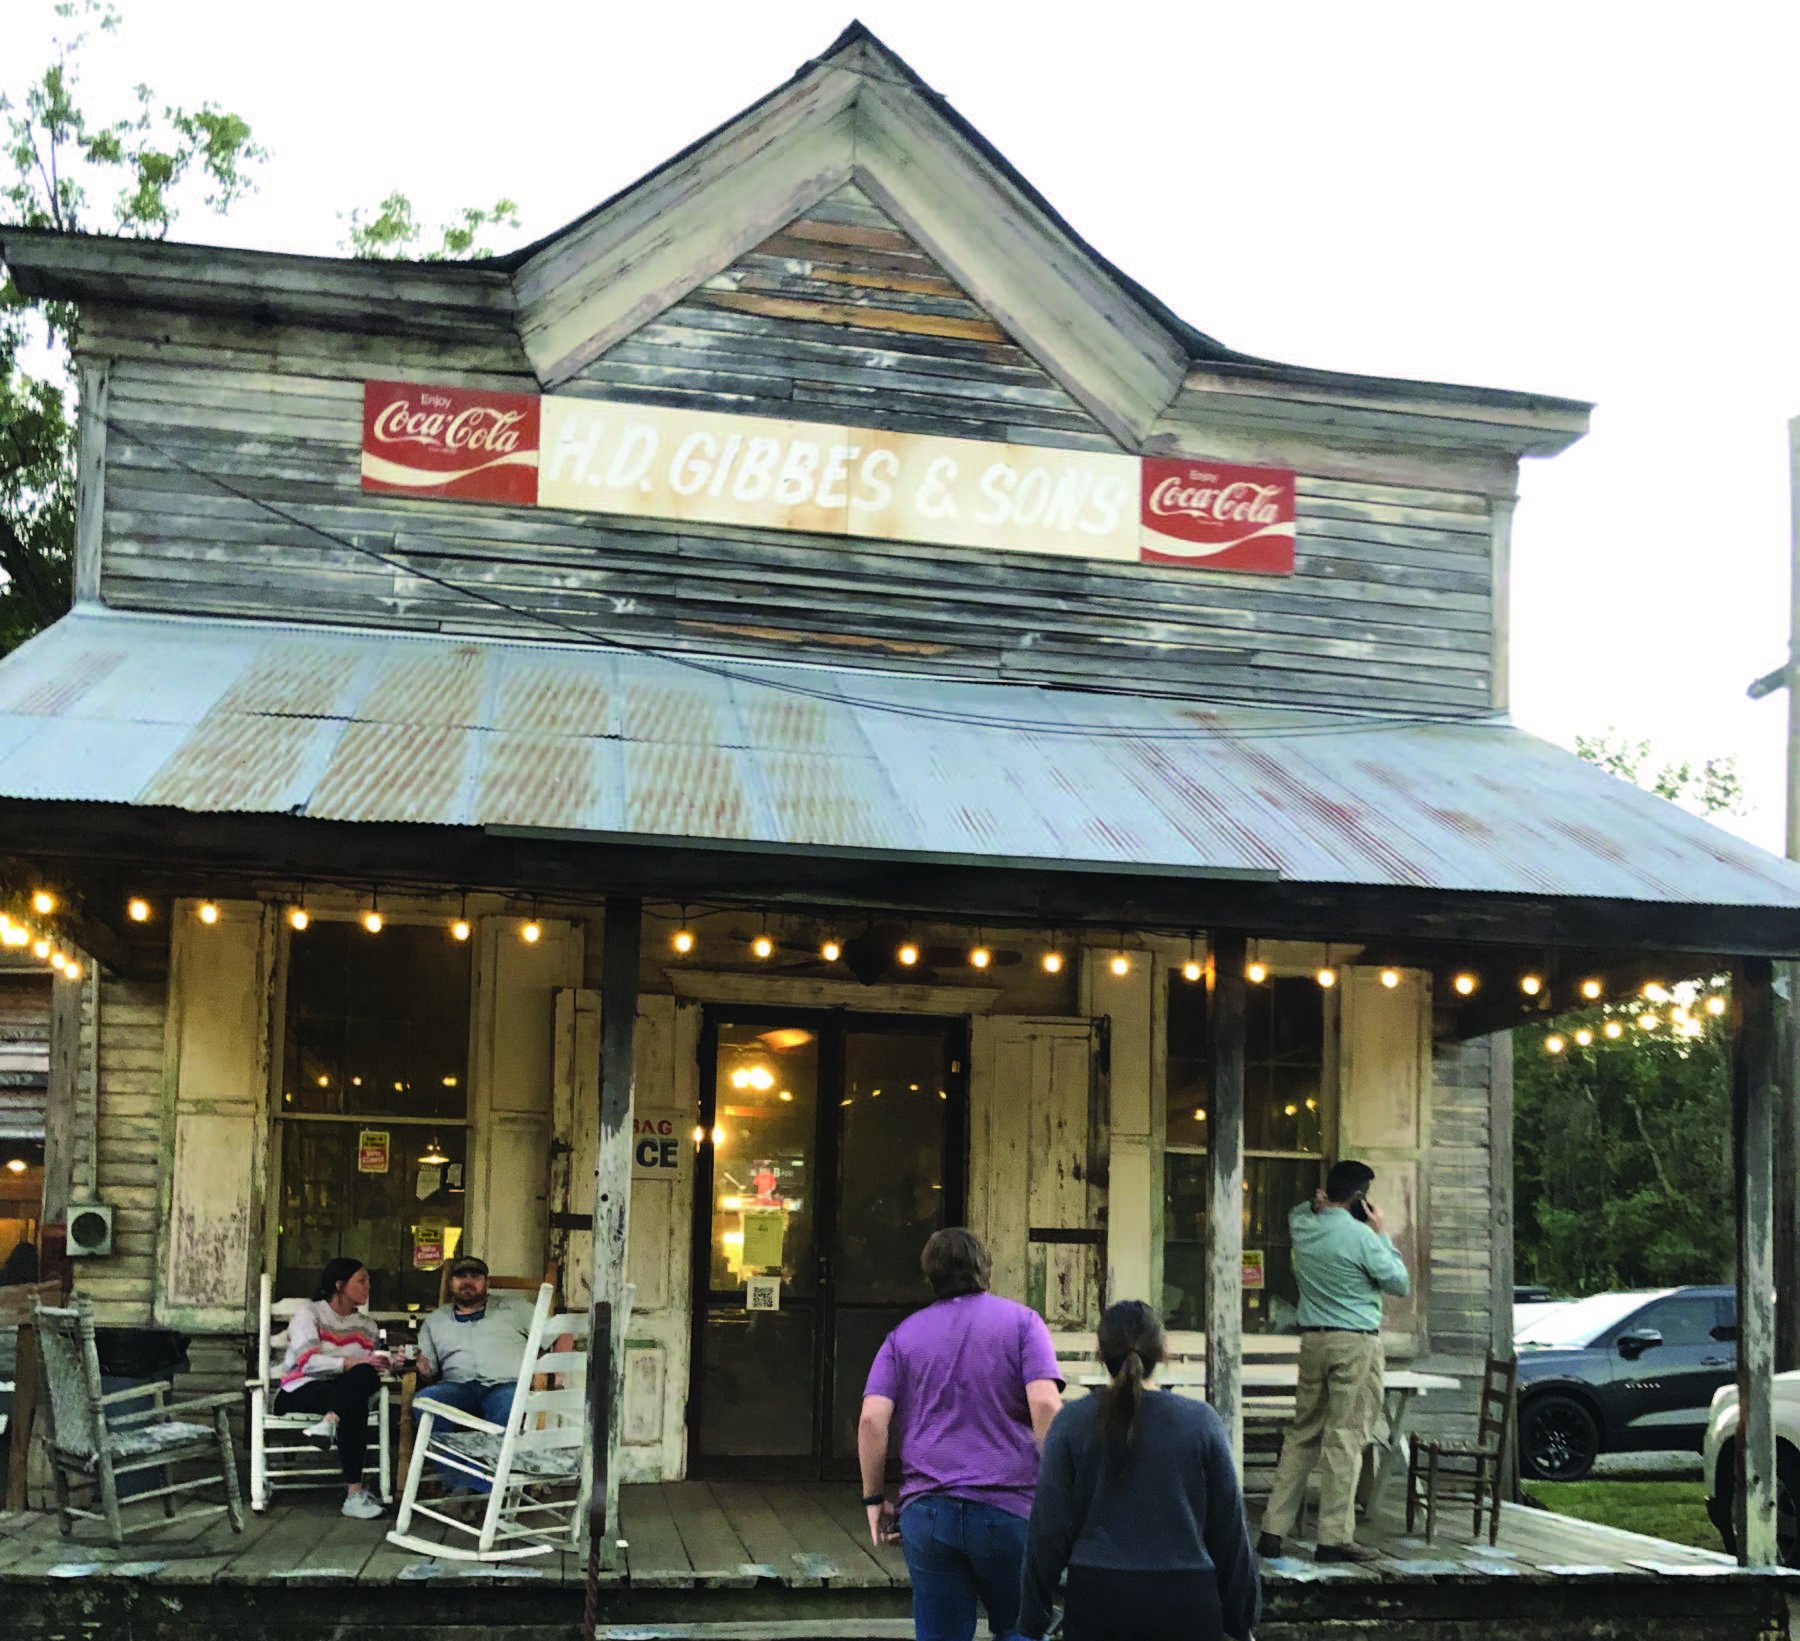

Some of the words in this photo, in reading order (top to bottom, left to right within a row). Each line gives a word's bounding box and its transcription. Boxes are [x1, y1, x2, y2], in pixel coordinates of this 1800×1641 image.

[421, 393, 451, 408] Enjoy
[373, 399, 528, 452] Coca-Cola
[549, 414, 660, 492] H.D.
[669, 431, 900, 512] GIBBES
[915, 456, 959, 518] &
[973, 463, 1129, 535] SONS
[1149, 476, 1286, 524] Coca-Cola
[636, 1138, 678, 1168] CE
